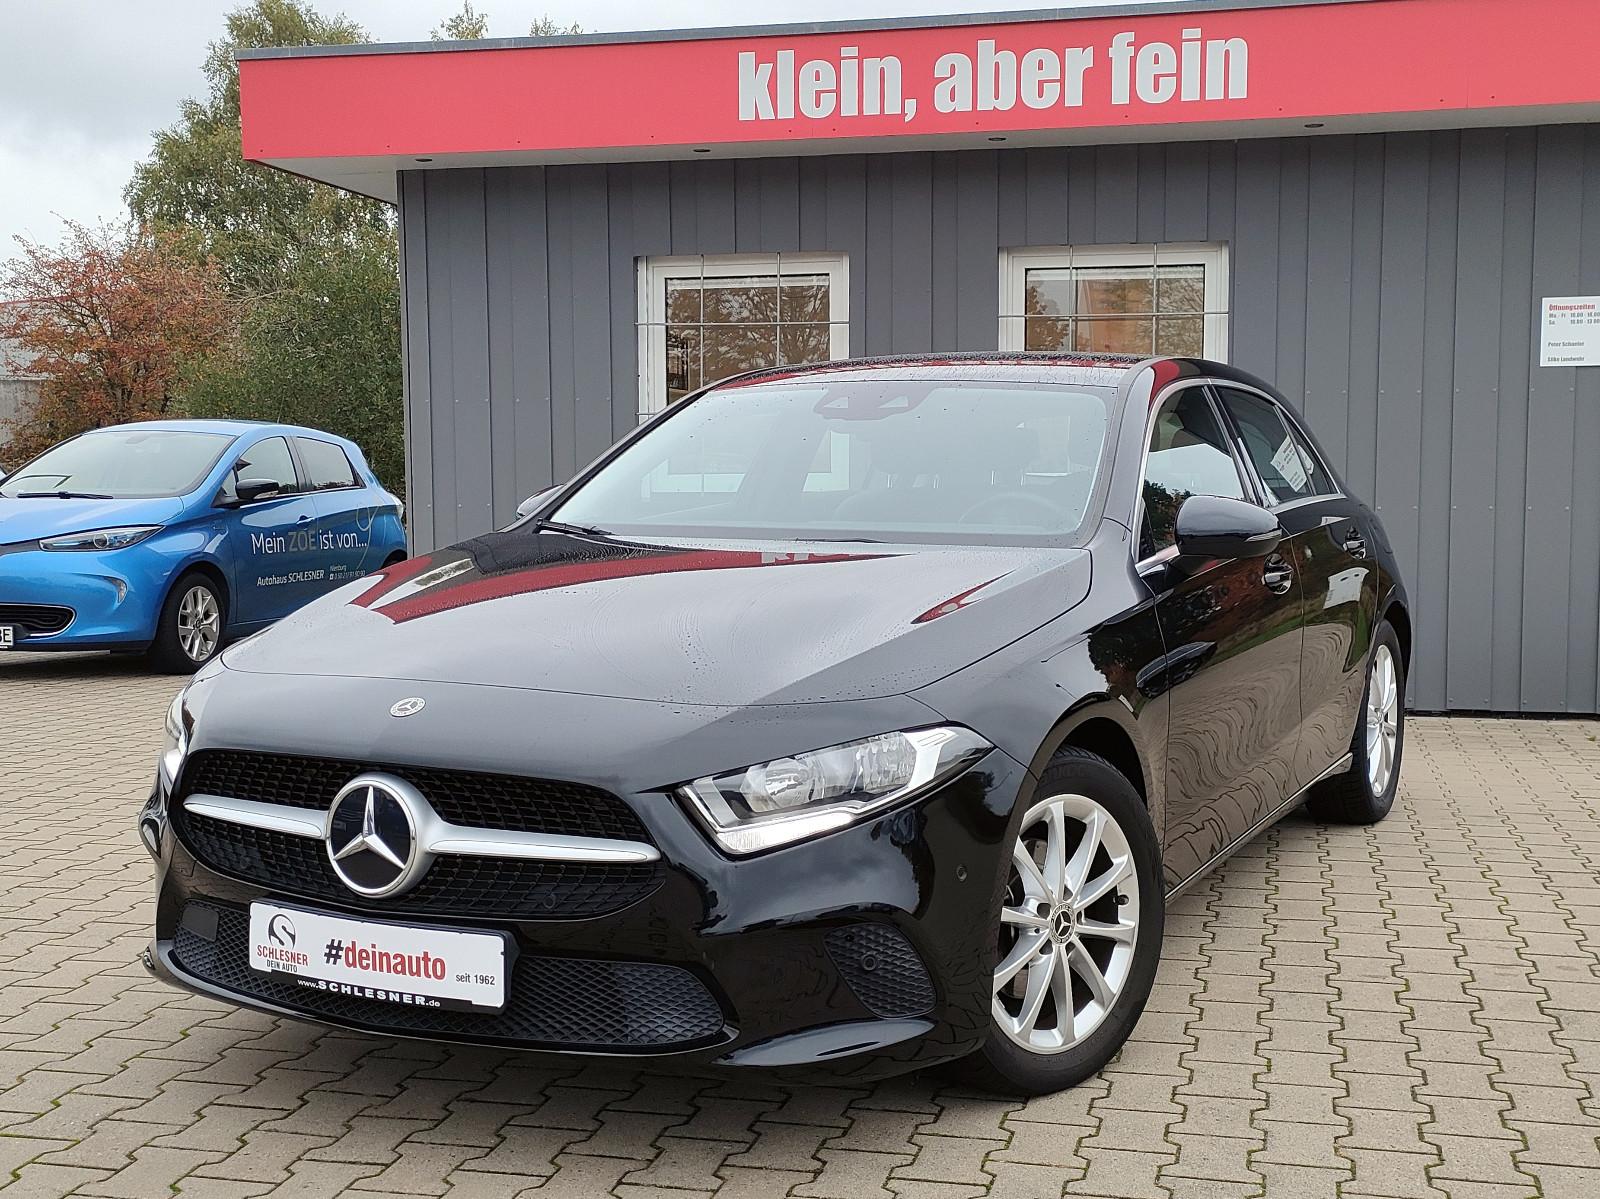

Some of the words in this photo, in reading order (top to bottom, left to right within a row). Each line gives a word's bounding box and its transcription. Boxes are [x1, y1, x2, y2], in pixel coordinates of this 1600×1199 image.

[737, 46, 918, 123] klein,
[933, 39, 1094, 114] aber
[1109, 28, 1249, 106] fein
[250, 531, 286, 555] Mein
[287, 530, 317, 552] ZOE
[319, 529, 334, 550] ist
[336, 532, 367, 549] von...
[256, 573, 287, 587] Autohaus
[288, 569, 325, 584] SCHLESNER
[256, 944, 309, 967] SCHLESNER
[266, 959, 281, 970] DEIN
[281, 962, 298, 973] AUTO
[323, 938, 447, 981] #deinauto
[455, 972, 471, 984] seit
[473, 974, 496, 986] 1962
[297, 979, 441, 1007] www.SCHLESNER.de
